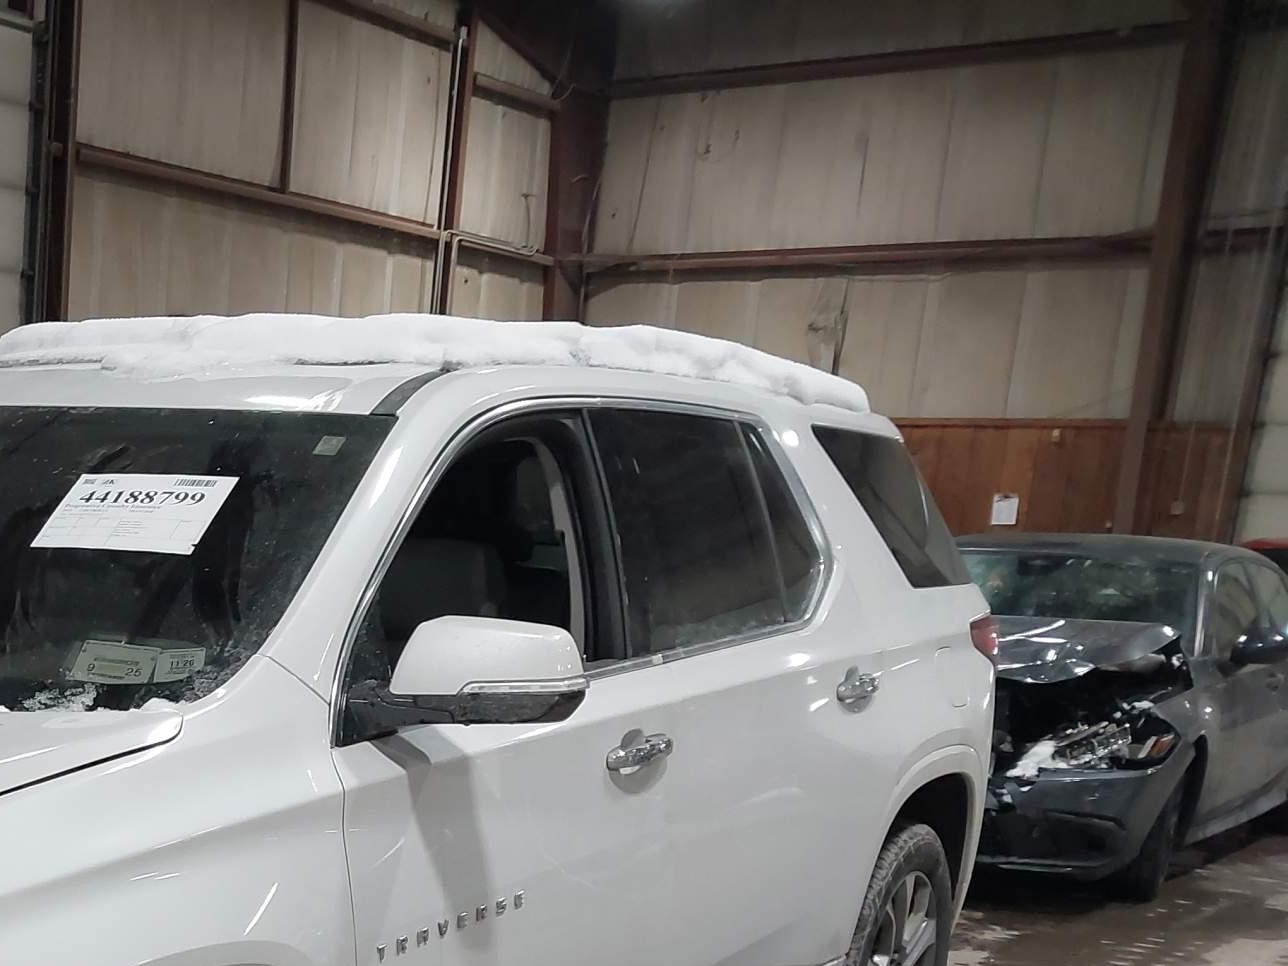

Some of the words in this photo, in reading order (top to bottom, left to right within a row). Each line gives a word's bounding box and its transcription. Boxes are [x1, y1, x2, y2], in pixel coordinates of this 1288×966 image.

[79, 490, 206, 506] 44188799
[86, 663, 96, 672] 9
[124, 667, 144, 677] 25
[376, 889, 526, 963] TRAVERSE
